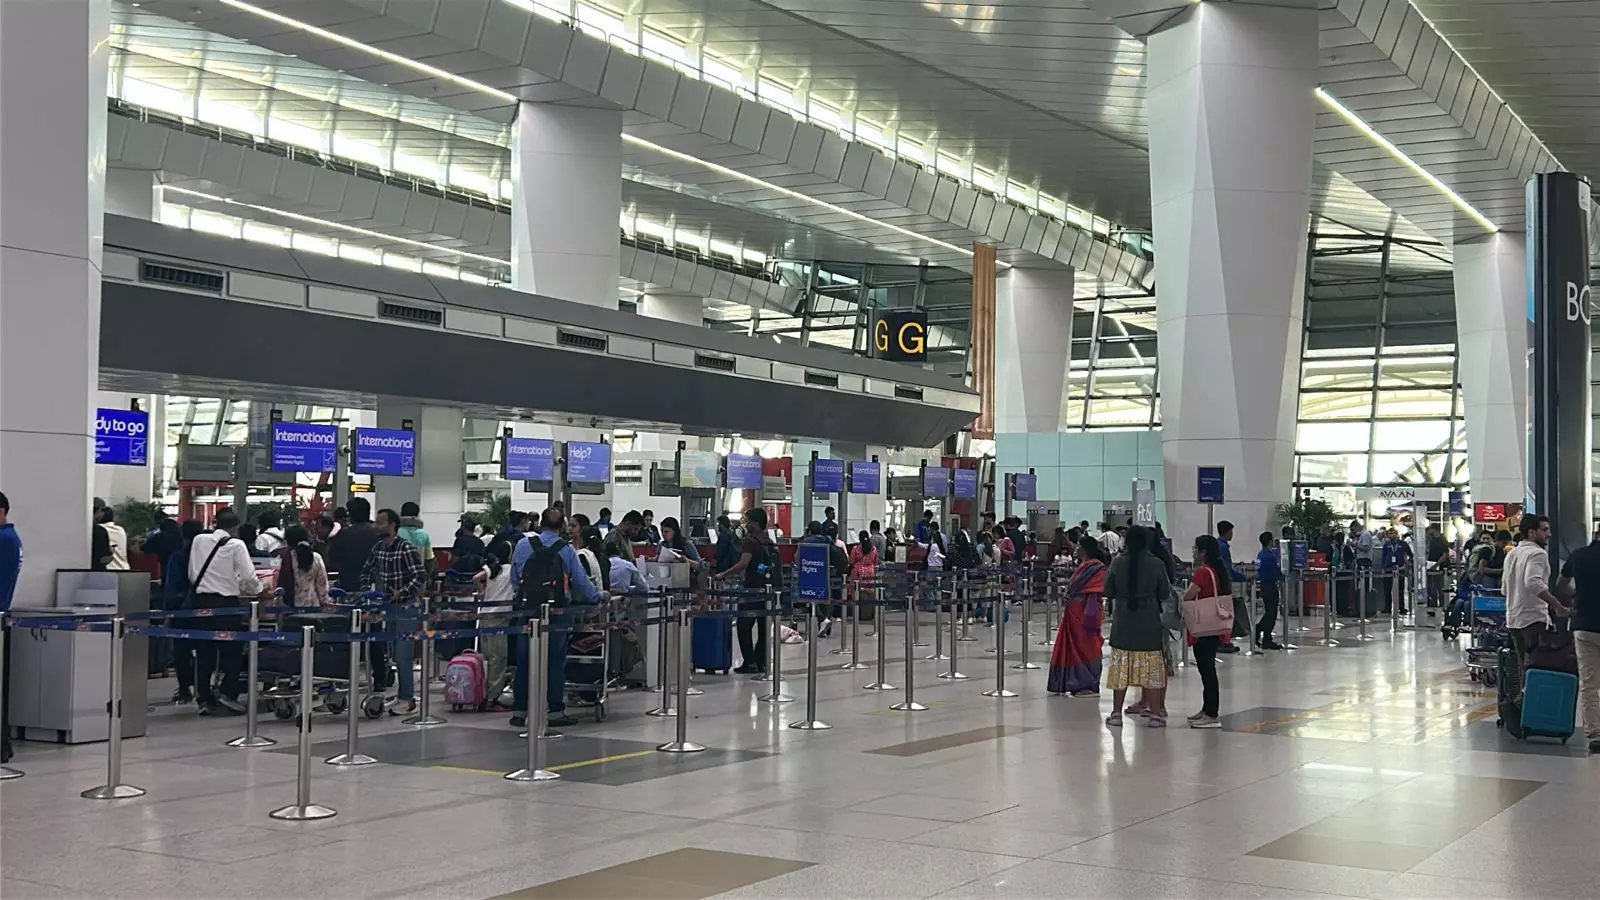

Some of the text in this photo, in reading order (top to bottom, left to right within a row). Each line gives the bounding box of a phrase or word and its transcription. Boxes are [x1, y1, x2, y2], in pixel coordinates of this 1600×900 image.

[875, 319, 889, 352] G
[898, 321, 924, 354] G
[112, 419, 126, 431] to
[127, 422, 145, 436] go
[275, 428, 335, 444] International
[358, 434, 413, 449] International
[508, 443, 552, 456] International
[569, 446, 592, 461] Help?
[1379, 490, 1415, 499] AVAAN
[801, 558, 825, 567] Domestic
[801, 566, 818, 574] flights
